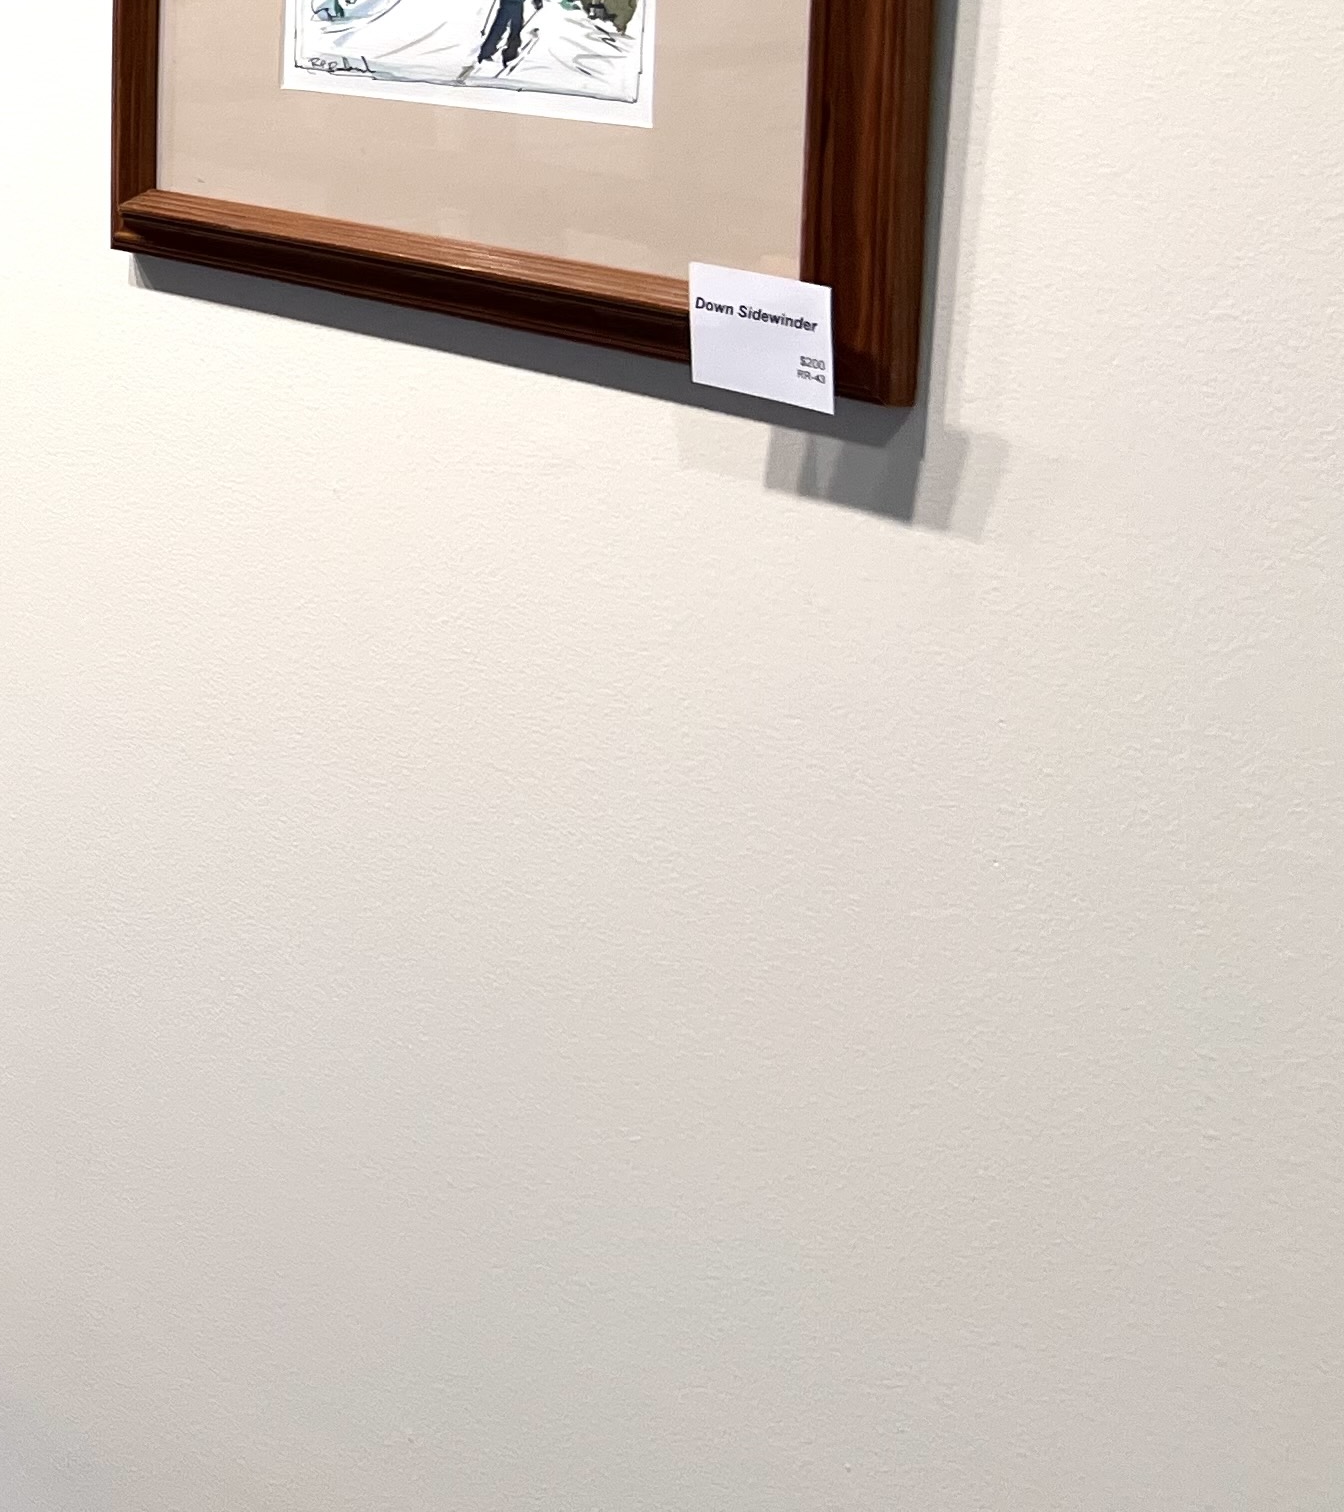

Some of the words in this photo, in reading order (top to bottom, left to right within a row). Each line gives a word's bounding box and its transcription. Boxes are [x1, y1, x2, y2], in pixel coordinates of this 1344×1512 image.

[695, 296, 734, 316] Down
[738, 305, 818, 333] Sidewinder
[800, 355, 826, 371] $200
